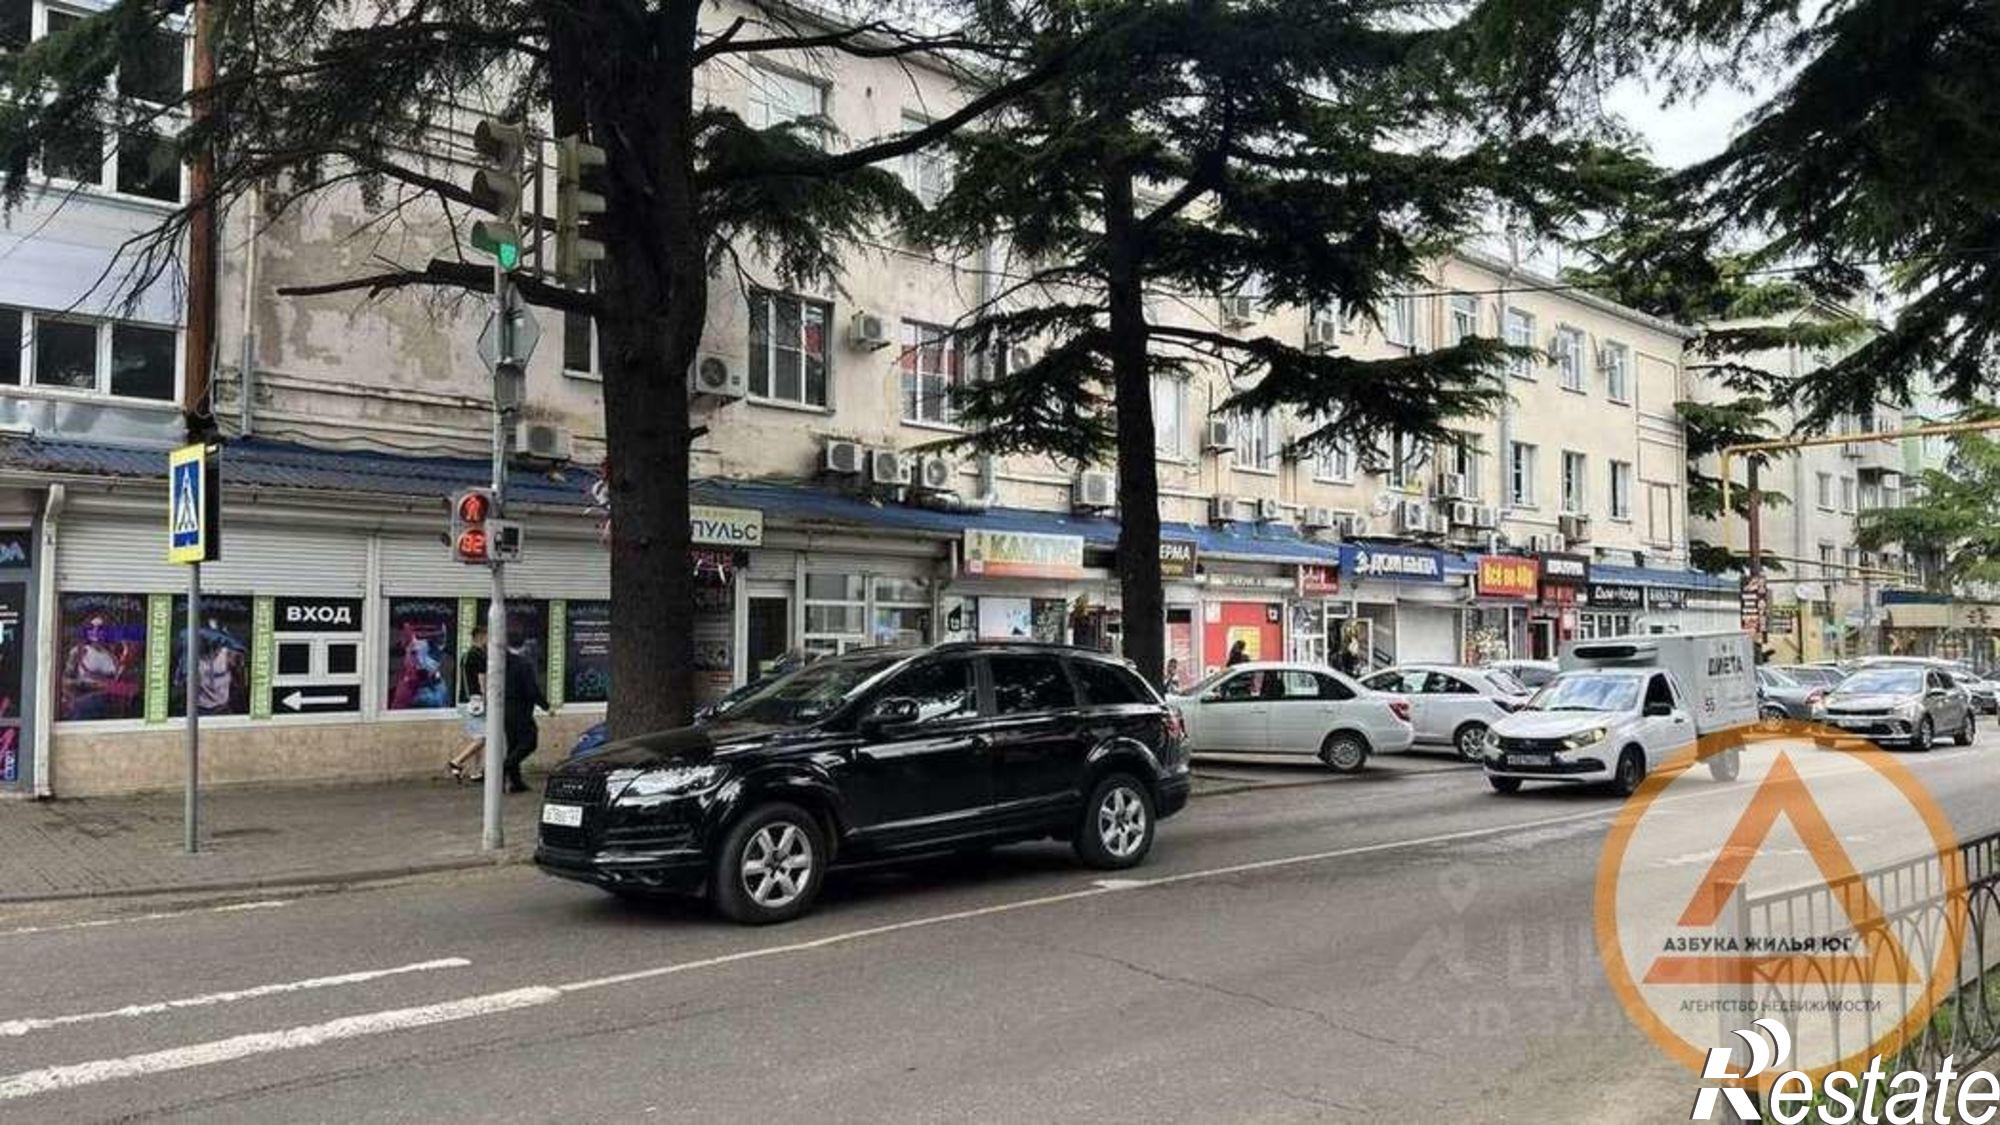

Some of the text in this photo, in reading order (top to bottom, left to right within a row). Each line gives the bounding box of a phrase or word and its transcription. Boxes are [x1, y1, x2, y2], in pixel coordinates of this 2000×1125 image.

[691, 520, 758, 541] ПУЛЬС
[1159, 544, 1192, 561] ЕРМА
[286, 606, 352, 624] ВХОД
